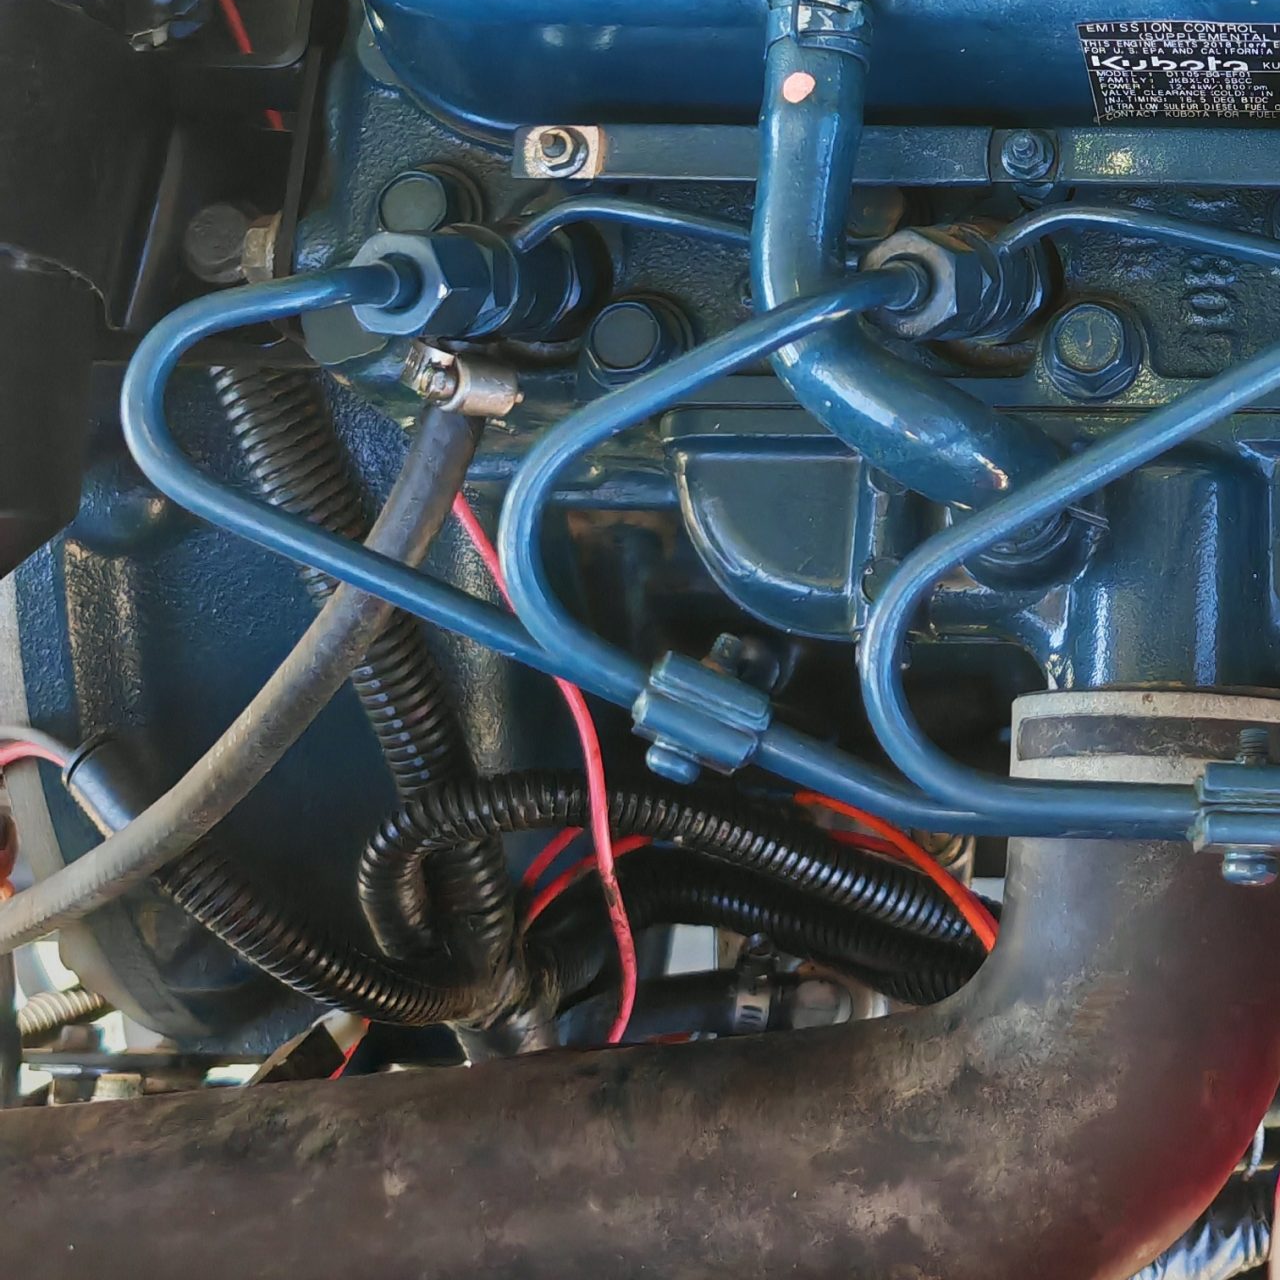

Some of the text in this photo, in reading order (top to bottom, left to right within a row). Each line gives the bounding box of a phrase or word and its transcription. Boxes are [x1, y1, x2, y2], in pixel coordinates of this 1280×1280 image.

[1086, 22, 1173, 33] EMISSION
[1183, 23, 1256, 34] CONTROL
[1138, 32, 1271, 42] (SUPPLEMENTAL
[1083, 40, 1110, 48] THIS
[1116, 40, 1156, 48] ENGINE
[1164, 40, 1198, 48] MEETS
[1203, 40, 1232, 48] 2018
[1200, 48, 1274, 56] CALIFORNIA
[1090, 55, 1249, 71] Kubota
[1214, 96, 1236, 104] DEG
[1240, 96, 1269, 104] BTDC
[1104, 103, 1134, 113] ULTRA
[1204, 103, 1238, 111] DIESEL
[1106, 110, 1158, 120] CONTACT
[1166, 110, 1210, 118] KUBOTA
[1249, 111, 1278, 119] FUEL
